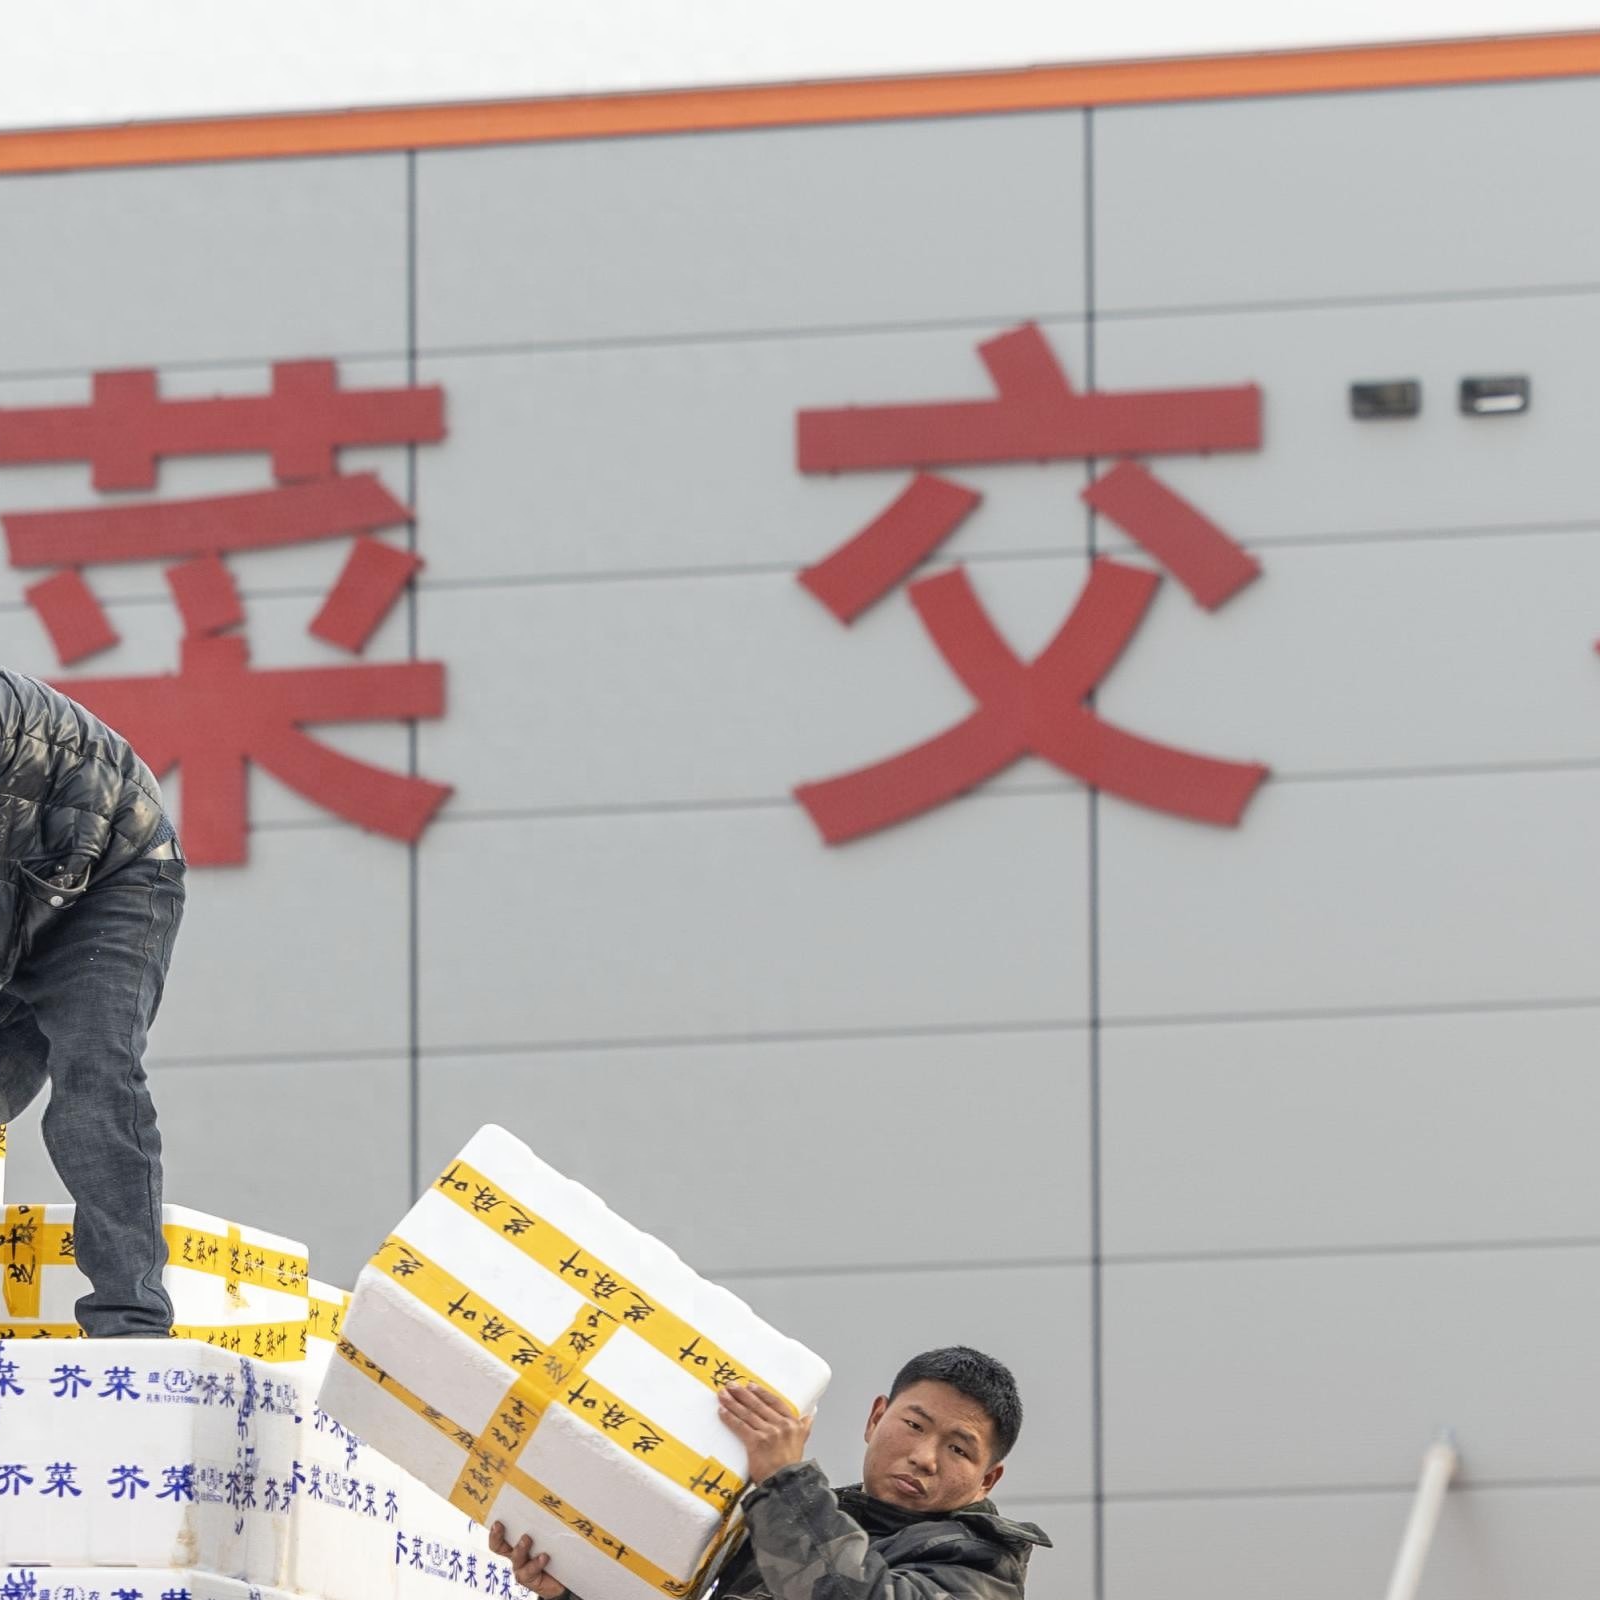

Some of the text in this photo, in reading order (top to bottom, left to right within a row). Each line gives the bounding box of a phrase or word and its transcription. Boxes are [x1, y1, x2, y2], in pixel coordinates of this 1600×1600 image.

[438, 1162, 658, 1325] 芝麻叶 芝麻叶
[51, 1363, 141, 1402] 芥菜
[445, 1290, 666, 1456] 芝麻叶 芝麻叶
[106, 1463, 195, 1503] 芥菜
